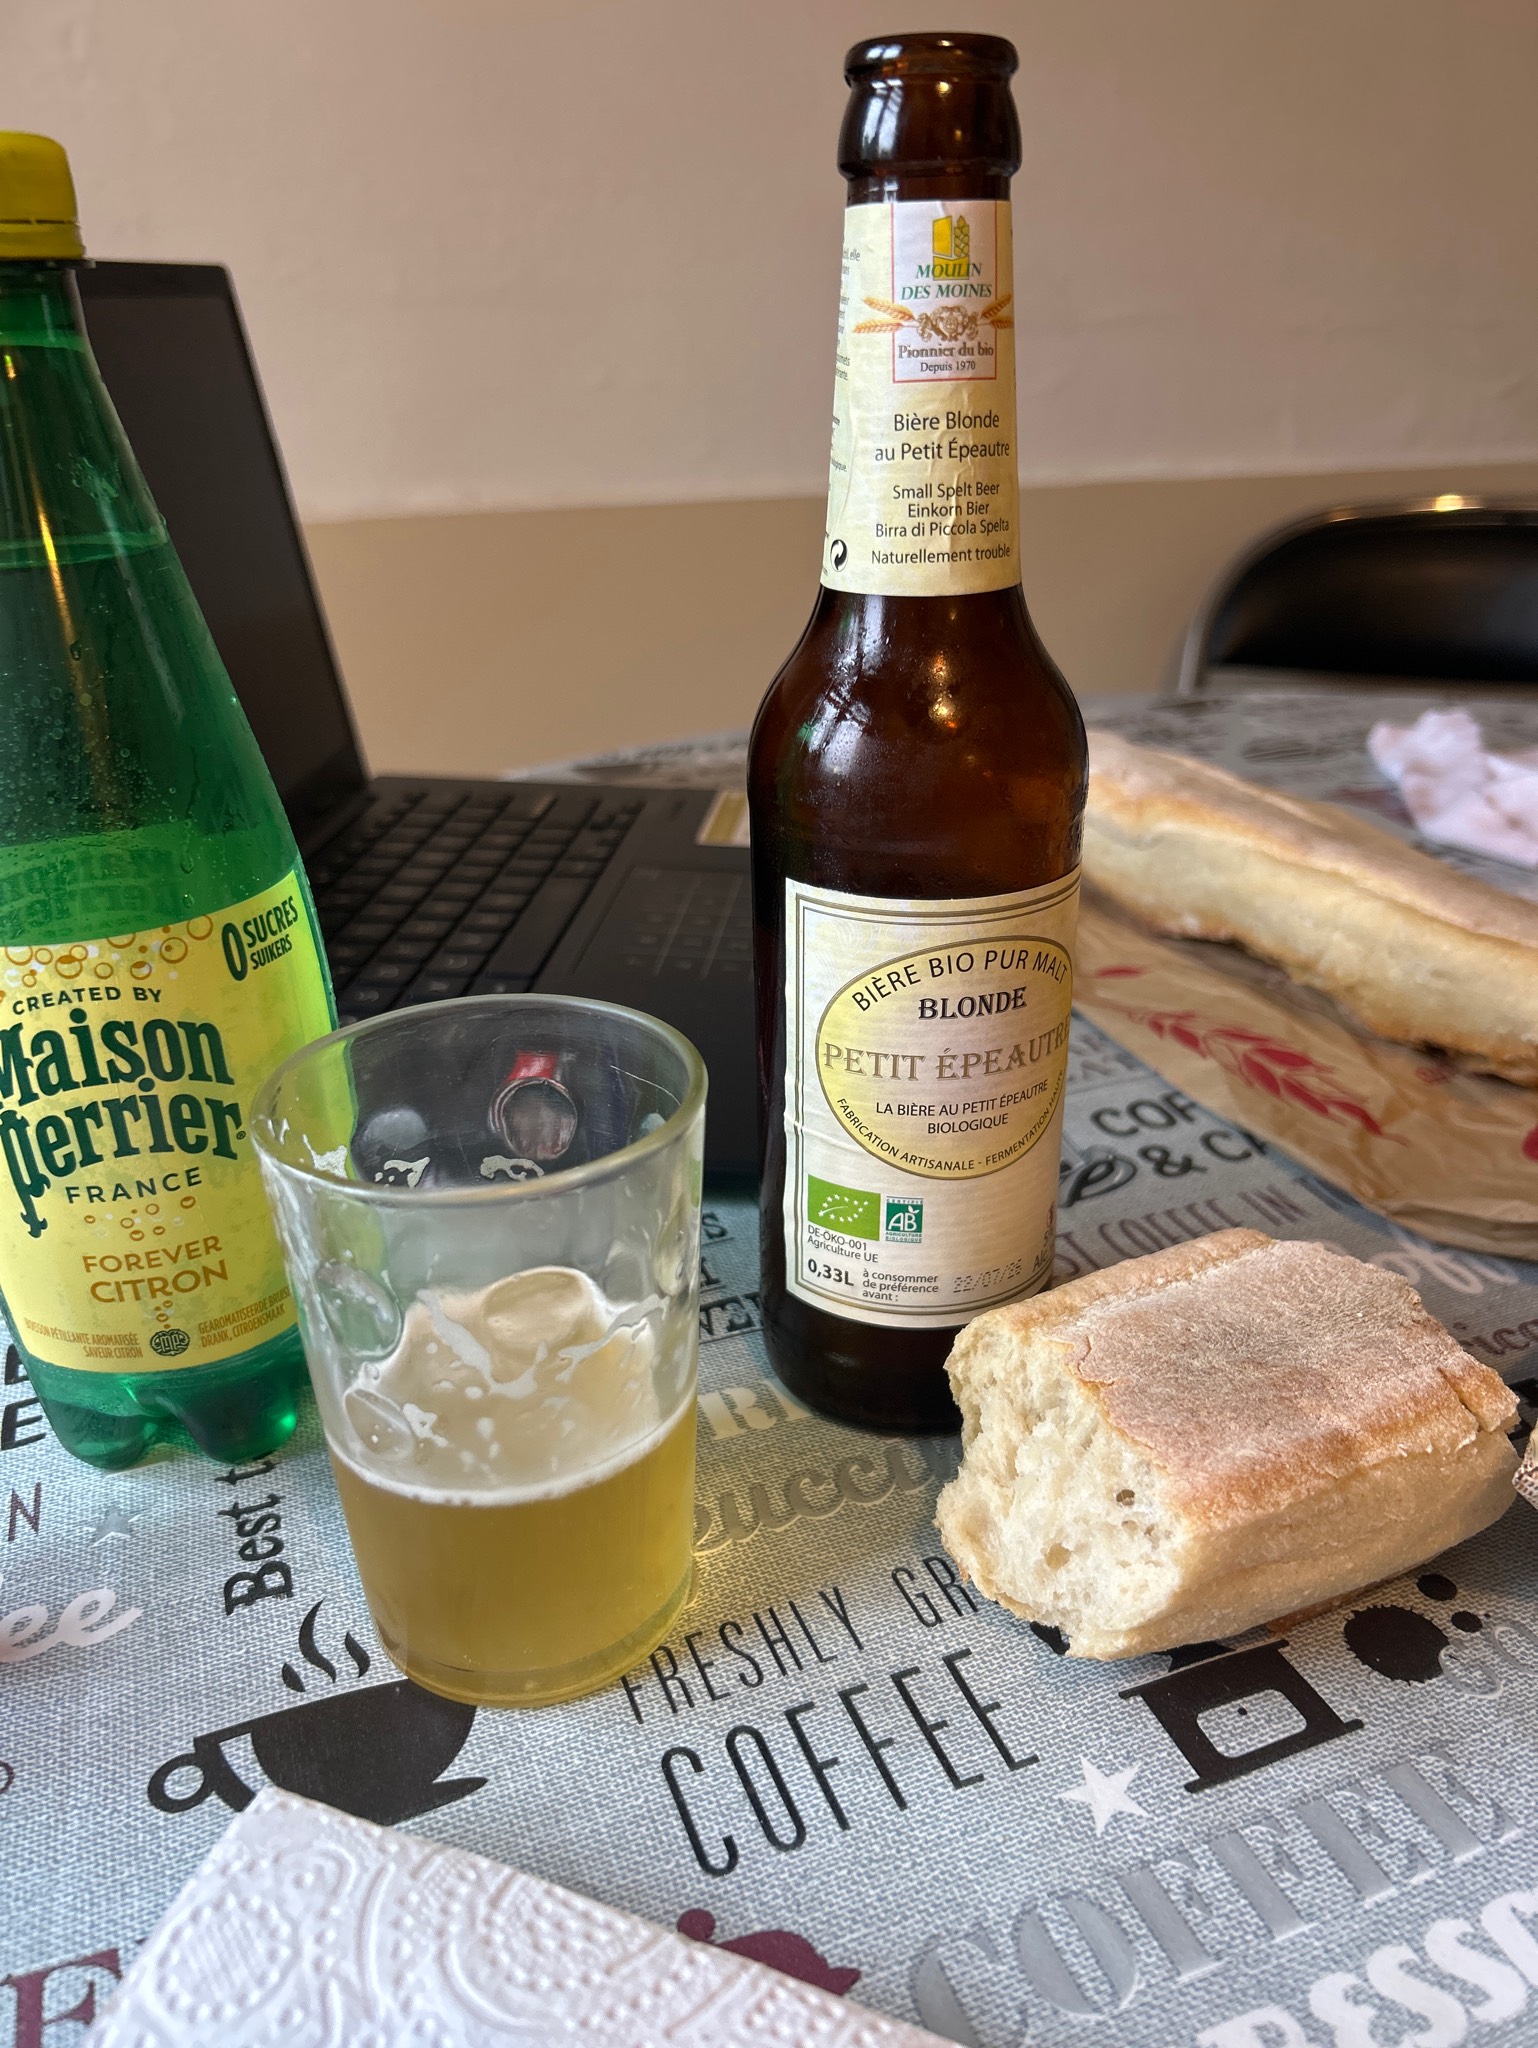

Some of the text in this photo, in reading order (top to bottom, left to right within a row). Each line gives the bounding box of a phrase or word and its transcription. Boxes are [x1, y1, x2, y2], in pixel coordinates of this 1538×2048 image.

[915, 262, 983, 279] MOULIN
[901, 283, 993, 300] DES MOINES
[897, 342, 994, 359] Pionnier du bio
[920, 360, 976, 374] Depuis 1970
[894, 410, 1000, 431] Bière Blonde
[875, 437, 1010, 462] au Petit Épeautre
[893, 481, 1000, 501] Small Spelt Beer
[908, 501, 990, 518] Einkorn Bier
[875, 518, 1009, 537] Birra di Piccola Spelta
[871, 544, 1010, 564] Naturellement trouble
[244, 896, 298, 948] SUCRES
[251, 934, 293, 970] SUIKERS
[852, 949, 1068, 1012] BIÈRE BIO PUR MALT
[13, 986, 162, 1015] CREATED BY
[918, 986, 1028, 1020] BLONDE
[823, 1042, 926, 1081] PETIT
[876, 1079, 1048, 1116] LA BIÈRE AU PETIT ÉPEAUTRE
[837, 1098, 899, 1158] FABRICATION
[900, 1153, 975, 1171] ARTISANALE
[985, 1110, 1050, 1167] FERMENTATION
[927, 1113, 1009, 1134] BIOLOGIQUE
[65, 1167, 203, 1204] FRANCE
[887, 1211, 918, 1232] AB
[807, 1235, 879, 1263] Agriculture UE
[808, 1224, 868, 1251] DE-ÖKO-001
[82, 1235, 222, 1273] FOREVER
[90, 1259, 229, 1303] CITRON
[807, 1258, 855, 1287] 0,33L
[862, 1267, 939, 1283] à consommer
[862, 1278, 939, 1294] de préférence
[862, 1289, 893, 1301] avant
[83, 1346, 144, 1358] SAVEUR CITRON
[620, 1586, 864, 1725] FRESHLY
[661, 1647, 1040, 1878] COFFEE
